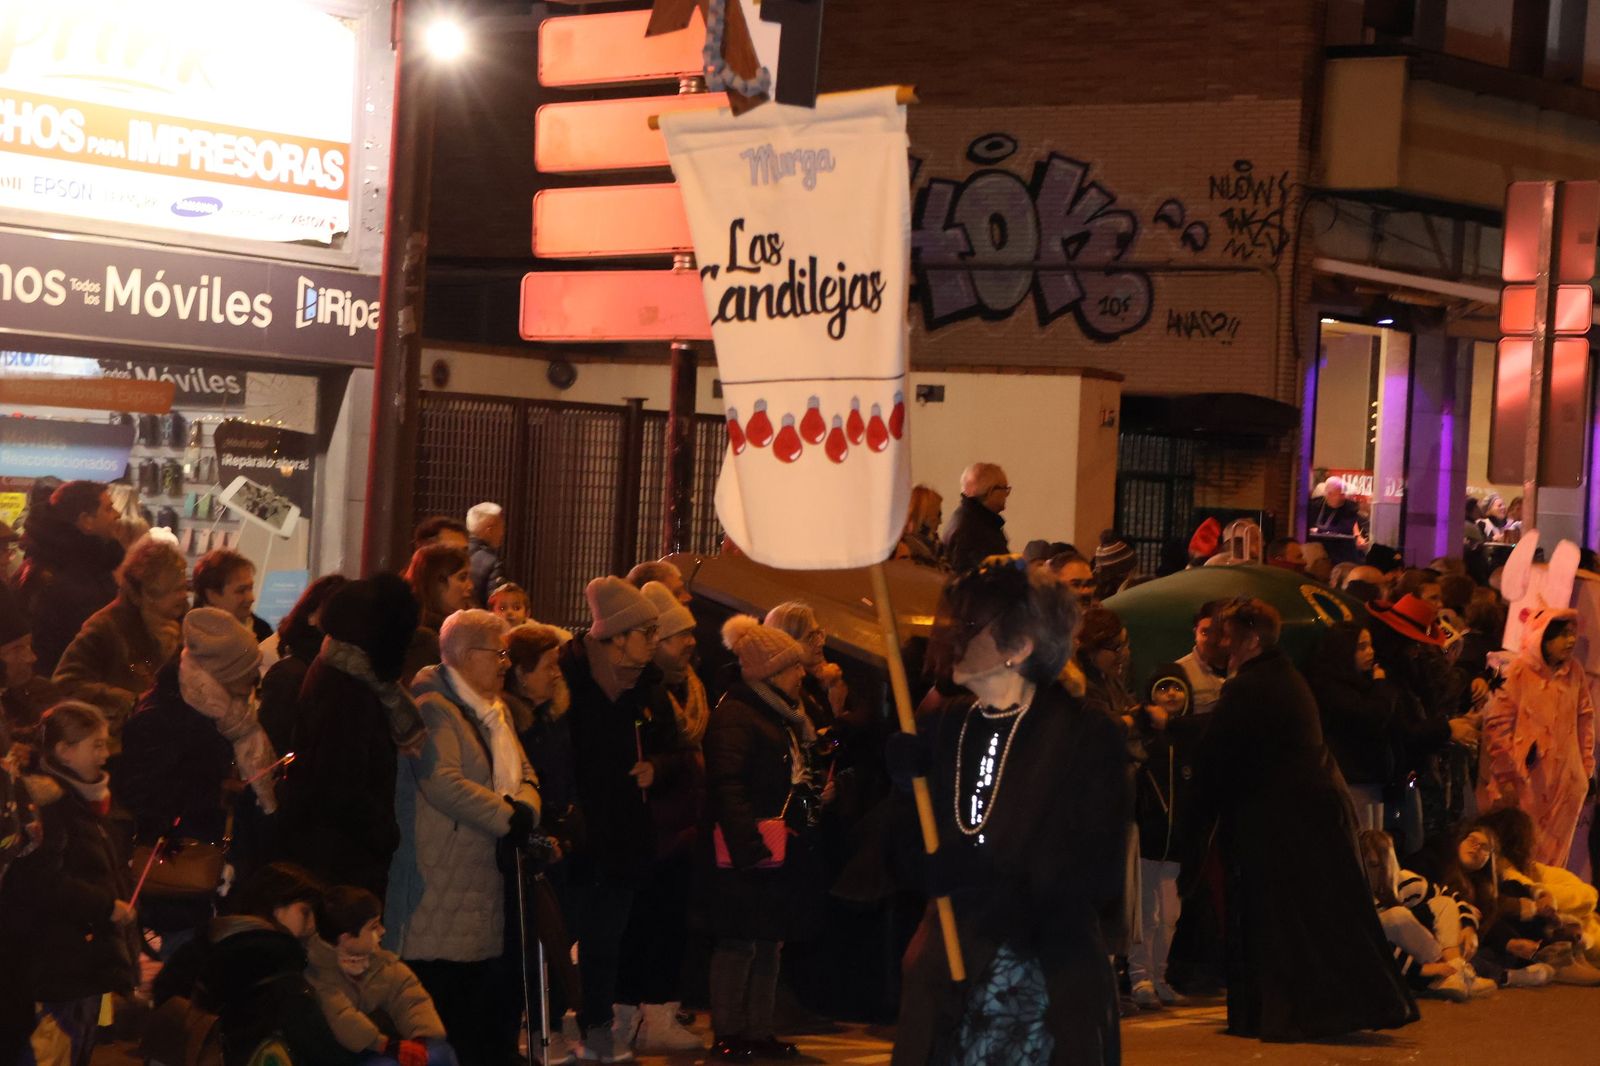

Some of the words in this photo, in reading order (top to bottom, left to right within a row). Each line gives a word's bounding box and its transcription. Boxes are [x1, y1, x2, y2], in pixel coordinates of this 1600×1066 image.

[0, 98, 85, 154] HOS
[128, 119, 345, 191] IMPRESORAS
[739, 143, 836, 191] Murga
[33, 175, 93, 201] EPSON
[726, 218, 784, 273] Las
[69, 278, 101, 293] Todos
[84, 291, 101, 306] los
[104, 265, 273, 329] Móviles
